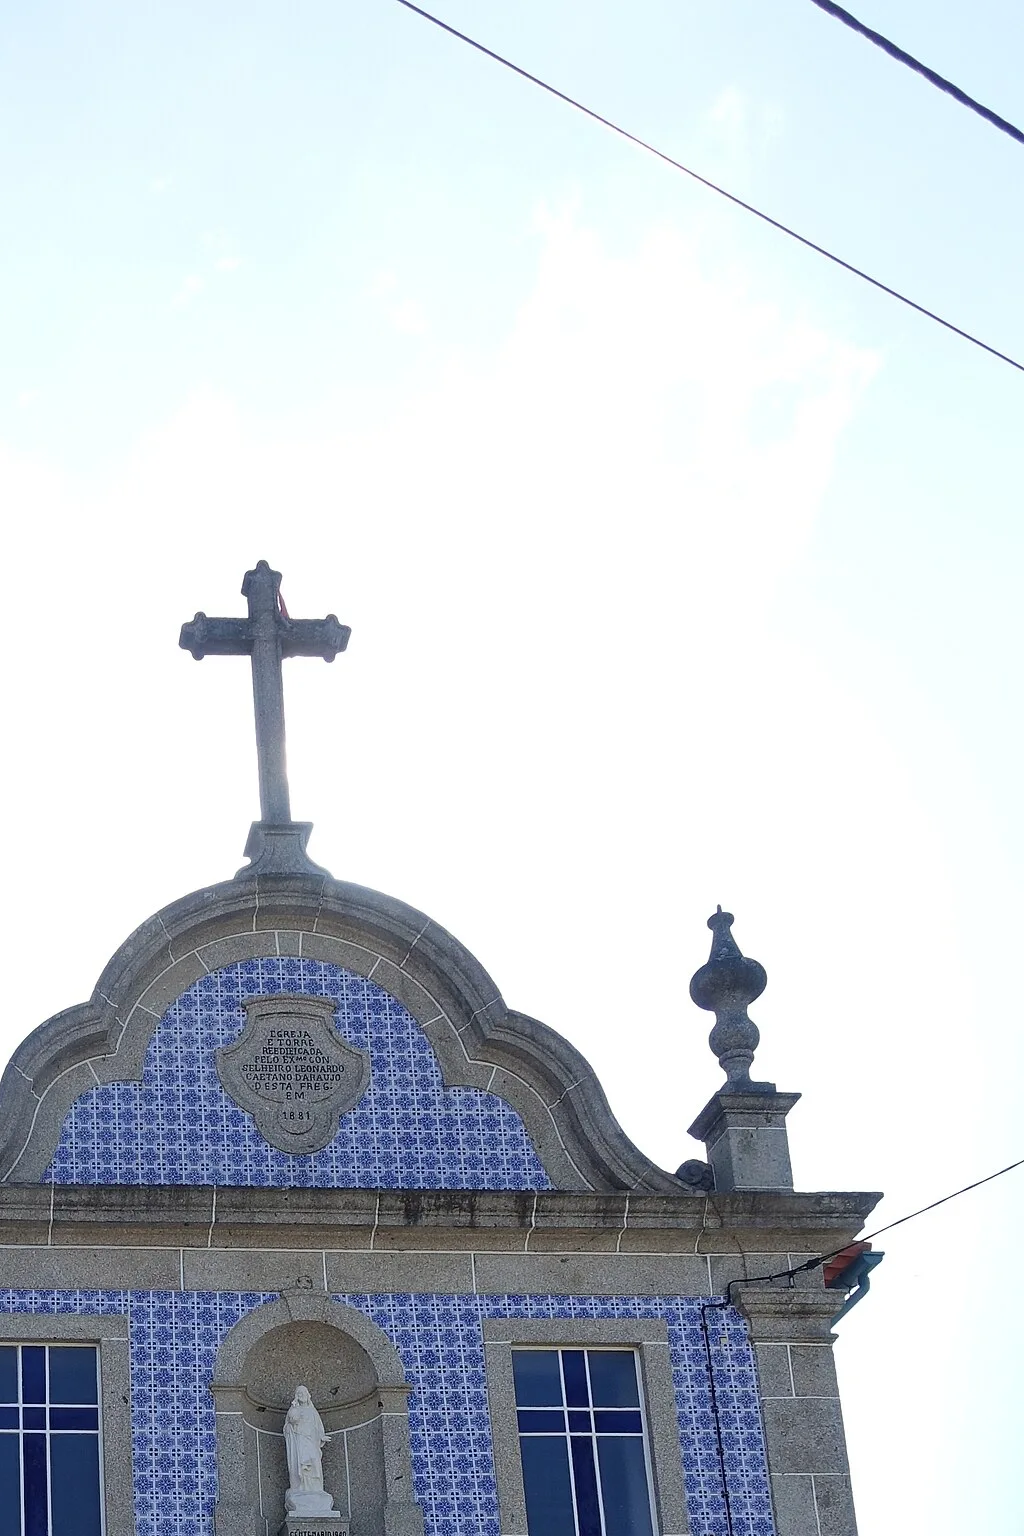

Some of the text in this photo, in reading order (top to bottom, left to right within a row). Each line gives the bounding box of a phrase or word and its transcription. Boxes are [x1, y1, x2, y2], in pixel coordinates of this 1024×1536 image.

[270, 1030, 311, 1039] EGREJA
[267, 1038, 315, 1047] E TORRE
[254, 1055, 279, 1064] PELO
[309, 1056, 330, 1064] CON
[241, 1064, 345, 1073] SELHEIRO LEONARDO
[246, 1073, 293, 1081] CAETANO
[254, 1082, 293, 1091] DESTA
[286, 1092, 305, 1100] EM
[282, 1111, 311, 1120] 1881
